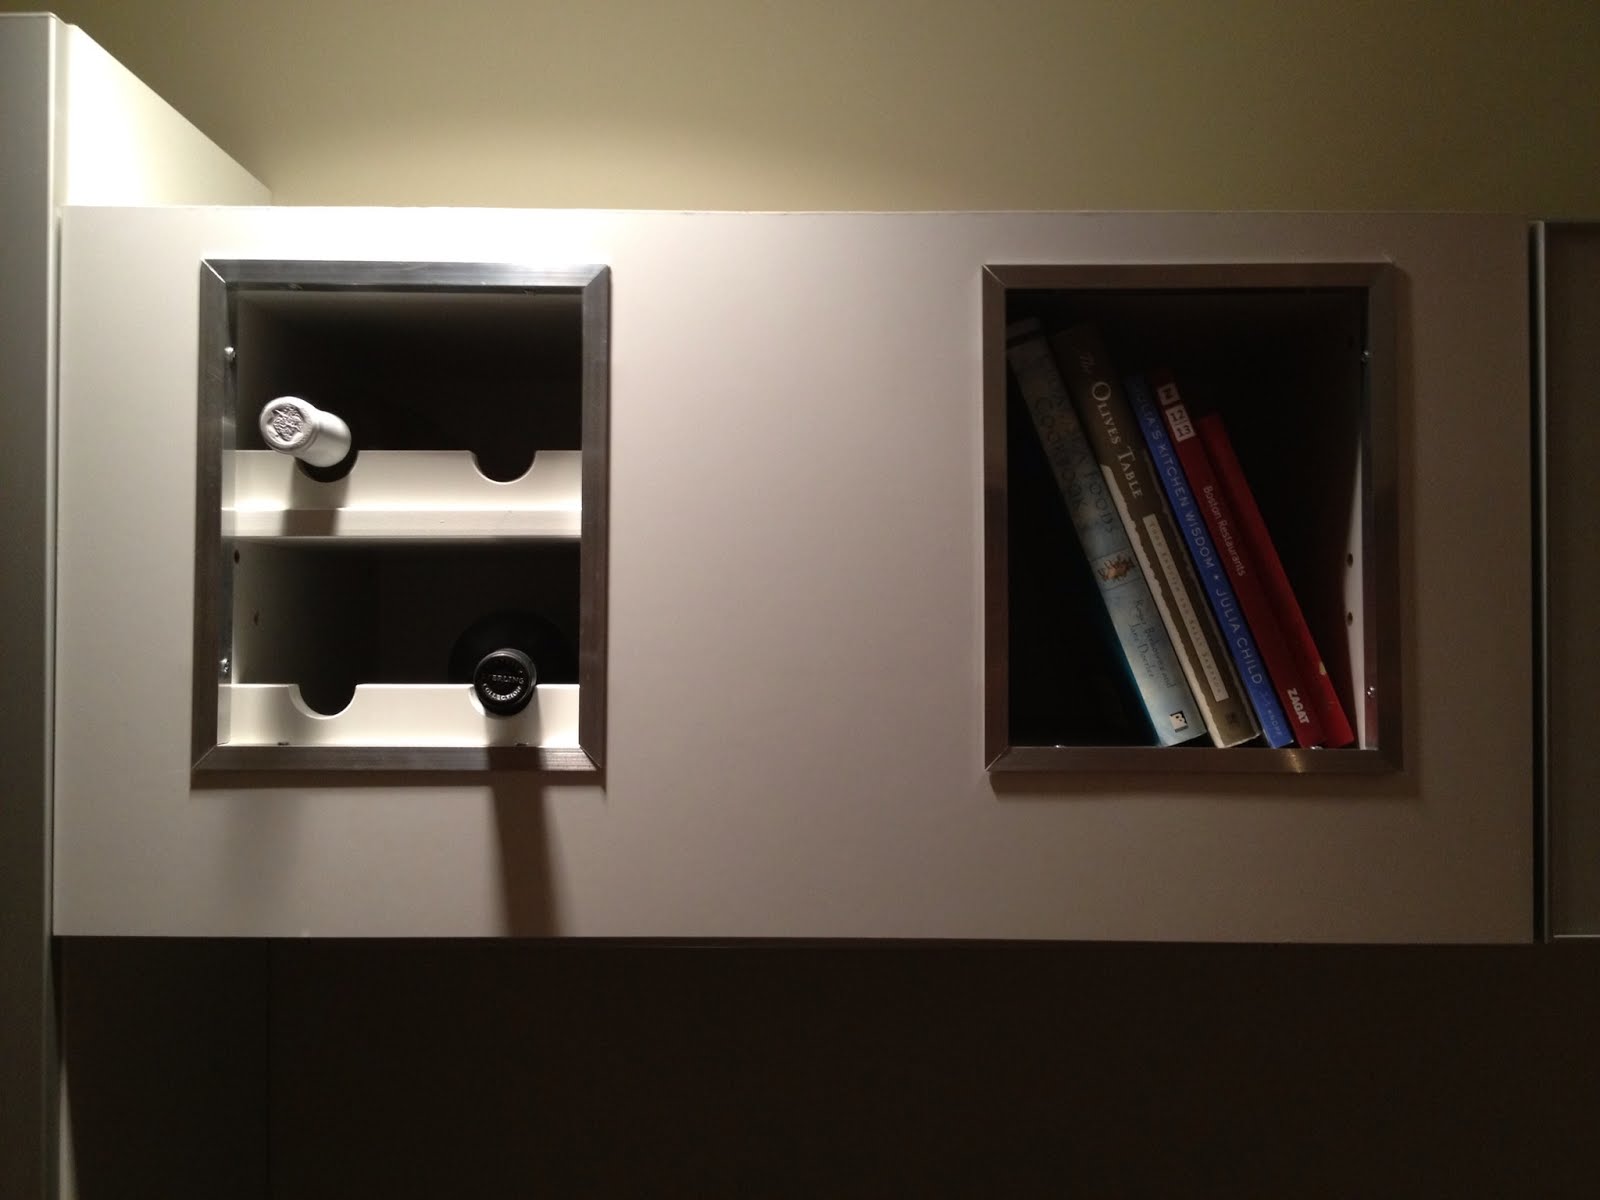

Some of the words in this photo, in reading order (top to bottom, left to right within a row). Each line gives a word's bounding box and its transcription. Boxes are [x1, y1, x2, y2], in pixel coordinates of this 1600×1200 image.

[1091, 382, 1122, 446] OLIVES
[1117, 446, 1144, 499] TABLE
[1169, 407, 1188, 424] 12
[1176, 423, 1192, 440] 13
[1158, 442, 1189, 508] KITCHEN
[1184, 508, 1217, 570] WISDOM
[1215, 588, 1242, 634] JULIA
[1237, 638, 1264, 686] CHILD
[1203, 484, 1222, 522] Boston
[1214, 520, 1248, 578] Restaurants
[1285, 687, 1311, 725] ZAGAT
